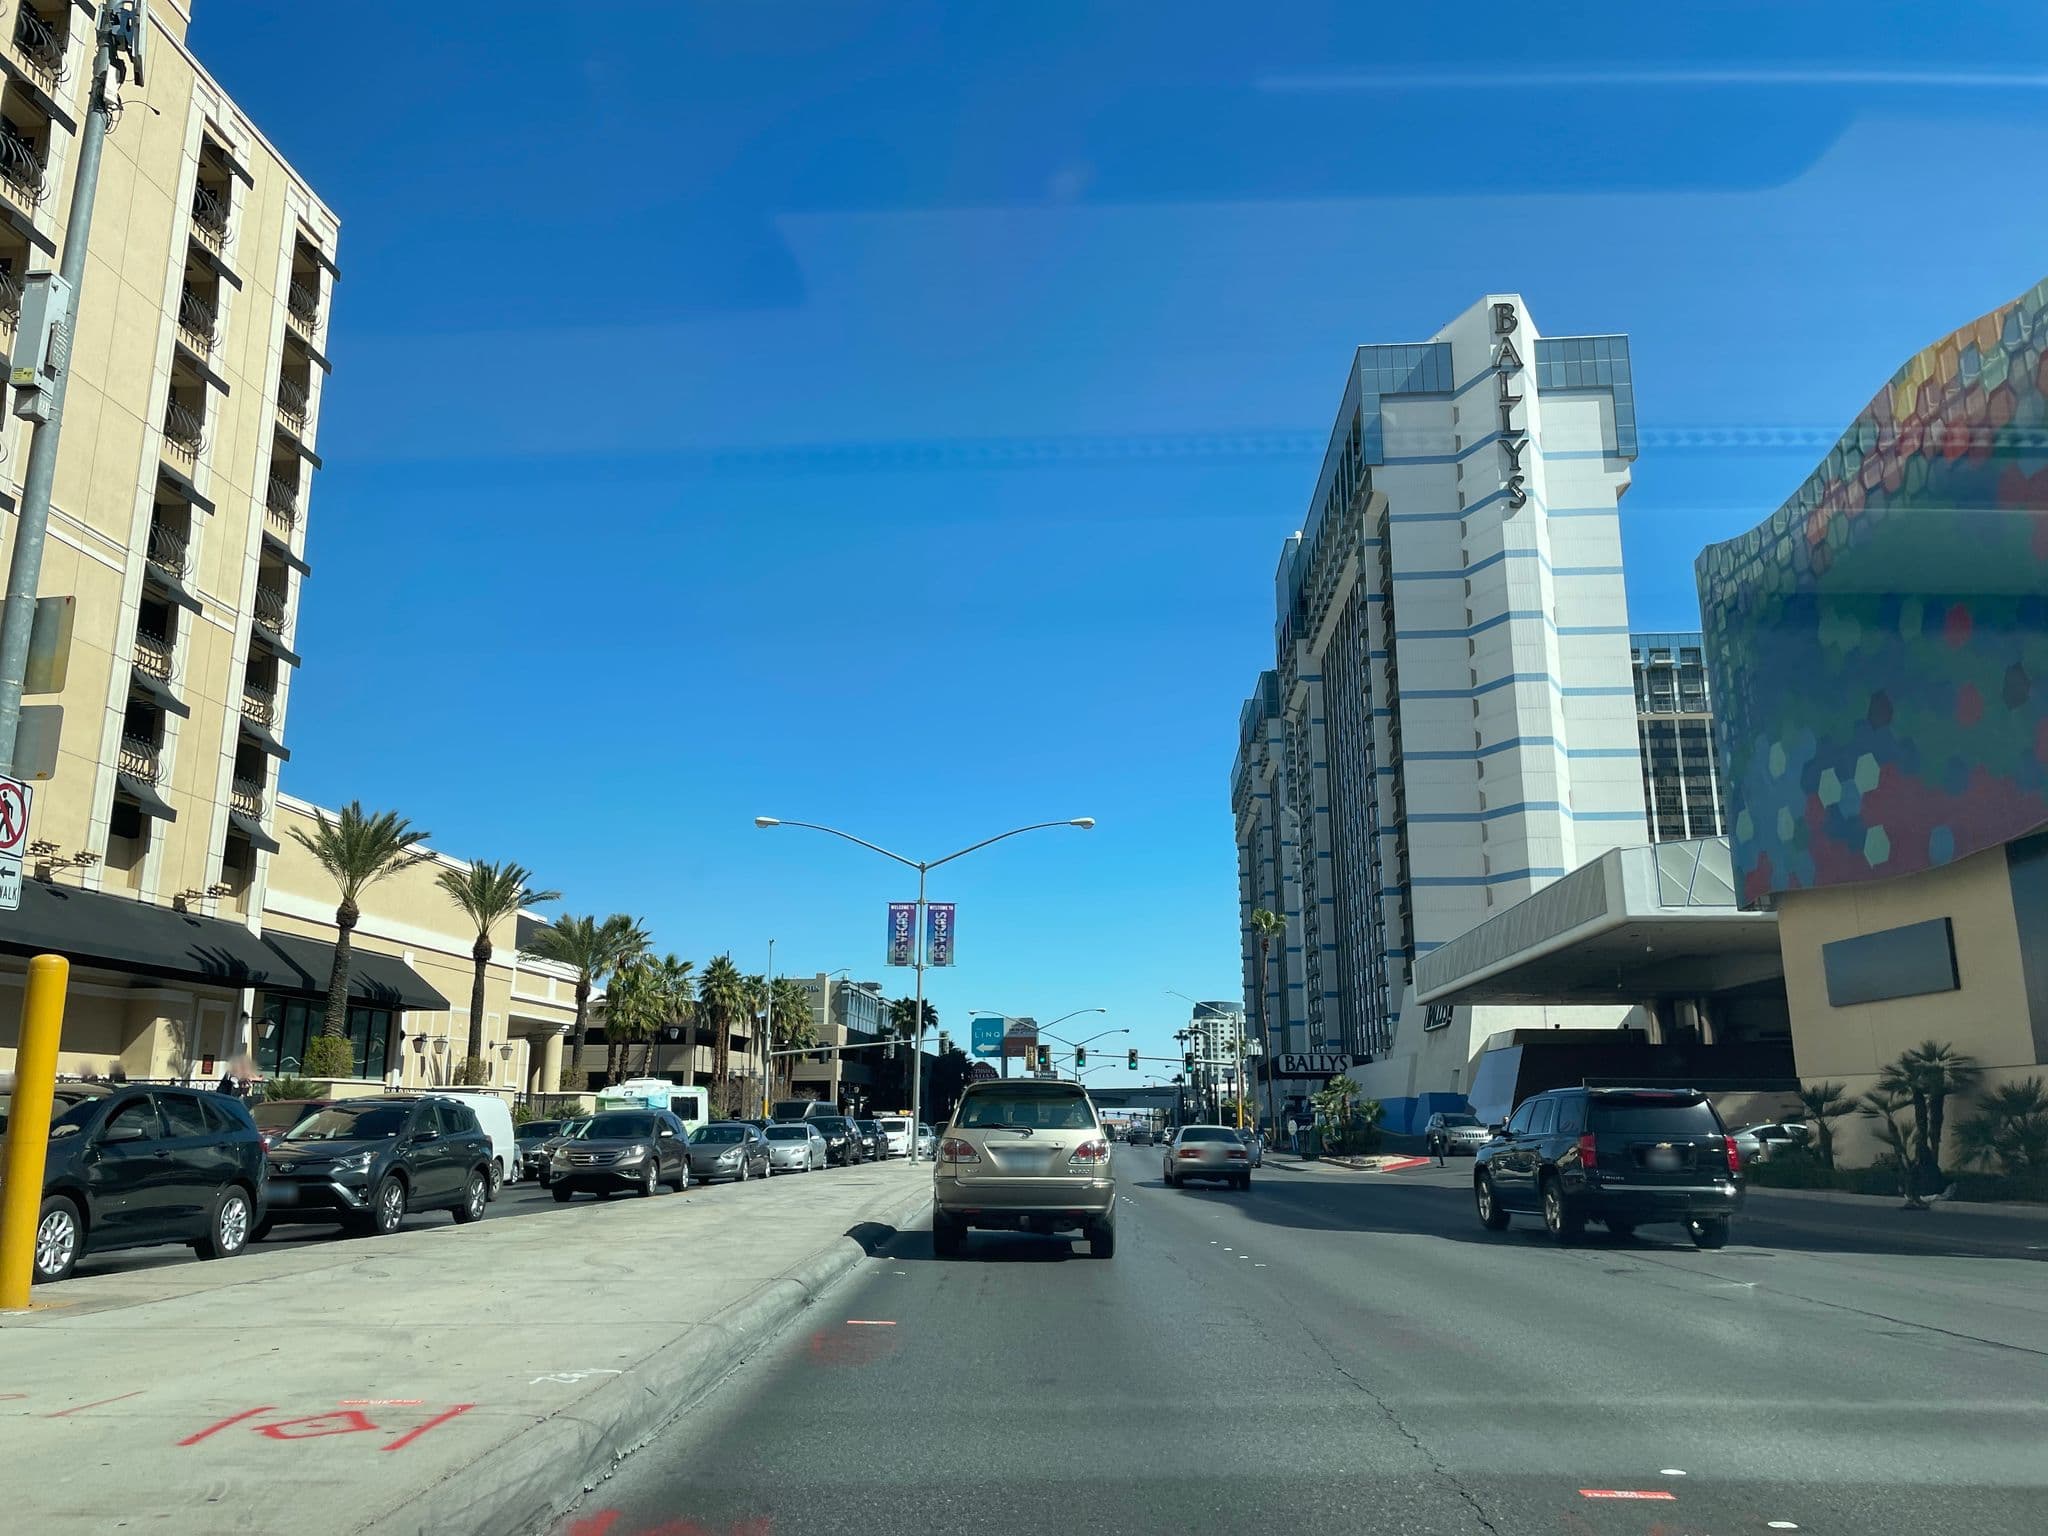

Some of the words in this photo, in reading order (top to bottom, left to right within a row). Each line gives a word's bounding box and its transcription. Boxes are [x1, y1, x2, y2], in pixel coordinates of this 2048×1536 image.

[1492, 302, 1529, 509] BALLYS
[896, 911, 909, 942] VEGAS
[935, 911, 947, 942] VEGAS
[895, 944, 907, 963] LAS
[934, 944, 946, 964] LAS
[1285, 1055, 1348, 1072] BALLYS
